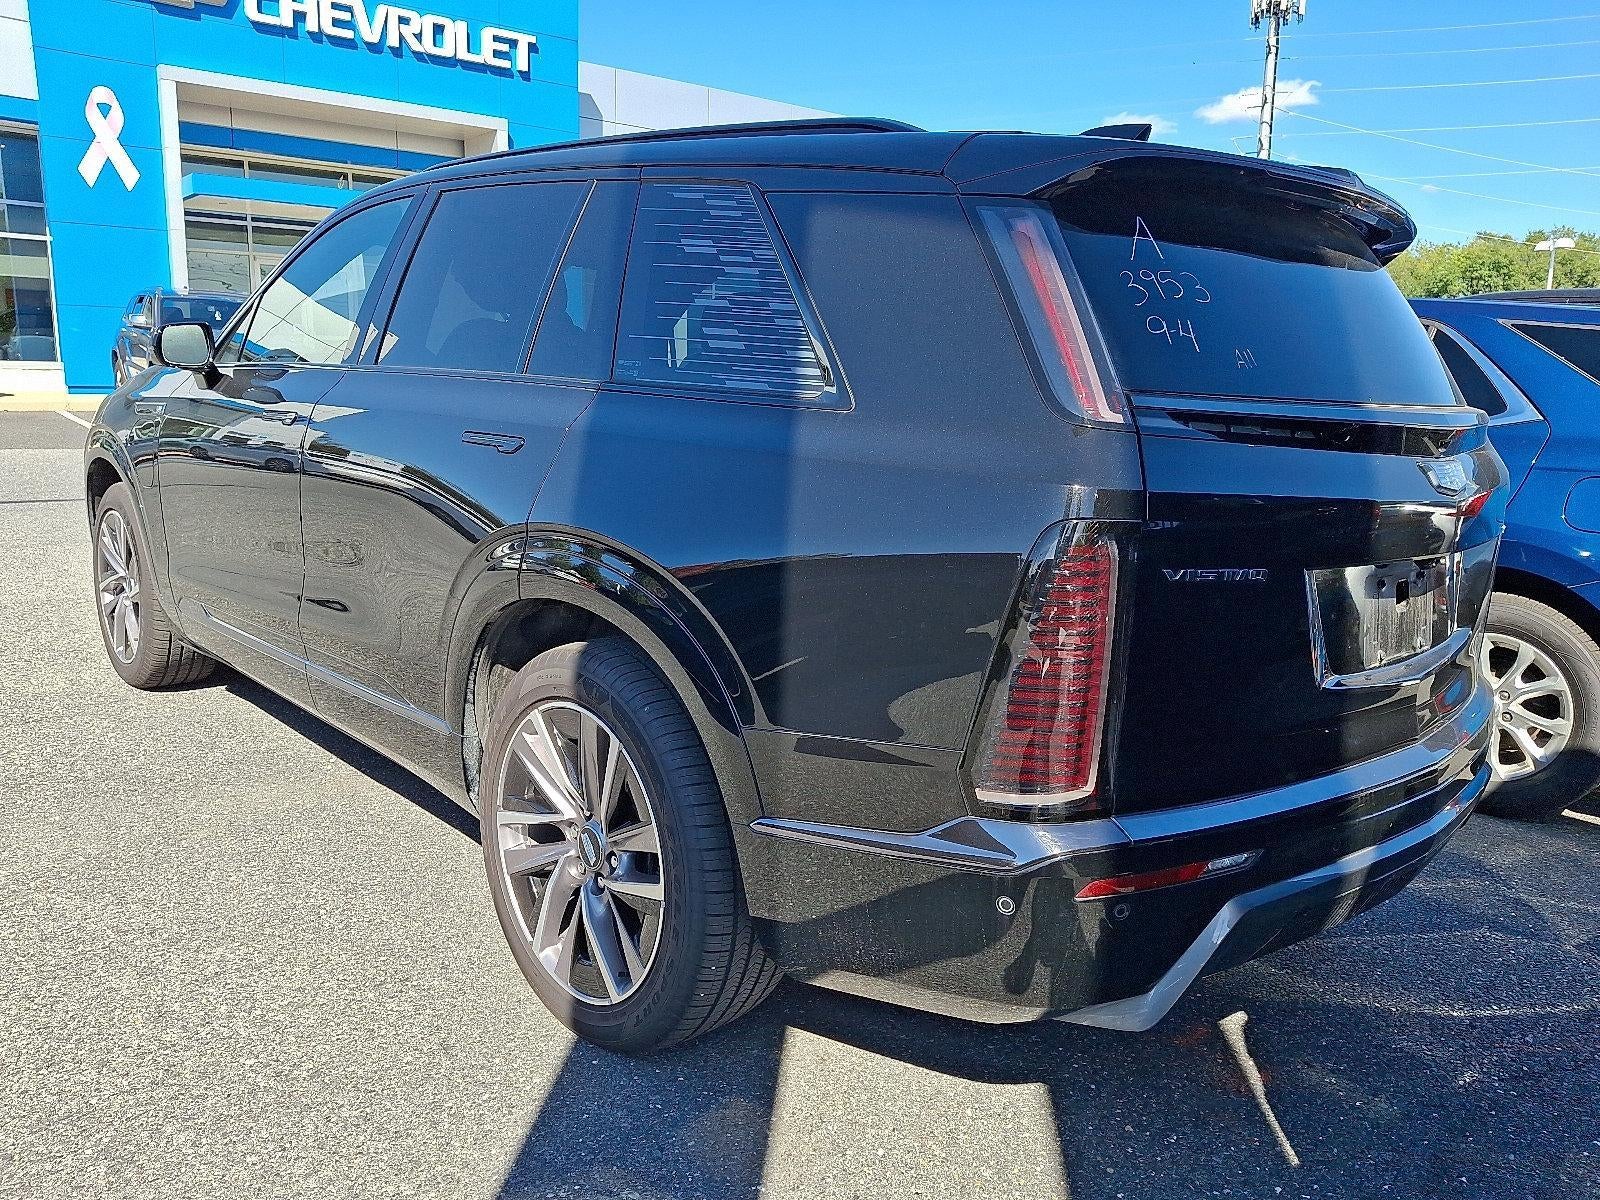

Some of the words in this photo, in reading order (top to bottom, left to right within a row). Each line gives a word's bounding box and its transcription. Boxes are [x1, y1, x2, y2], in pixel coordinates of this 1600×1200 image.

[243, 0, 537, 72] CHEVROLET
[1130, 216, 1164, 261] A
[1119, 269, 1211, 306] 3953
[1146, 315, 1200, 353] 9-4
